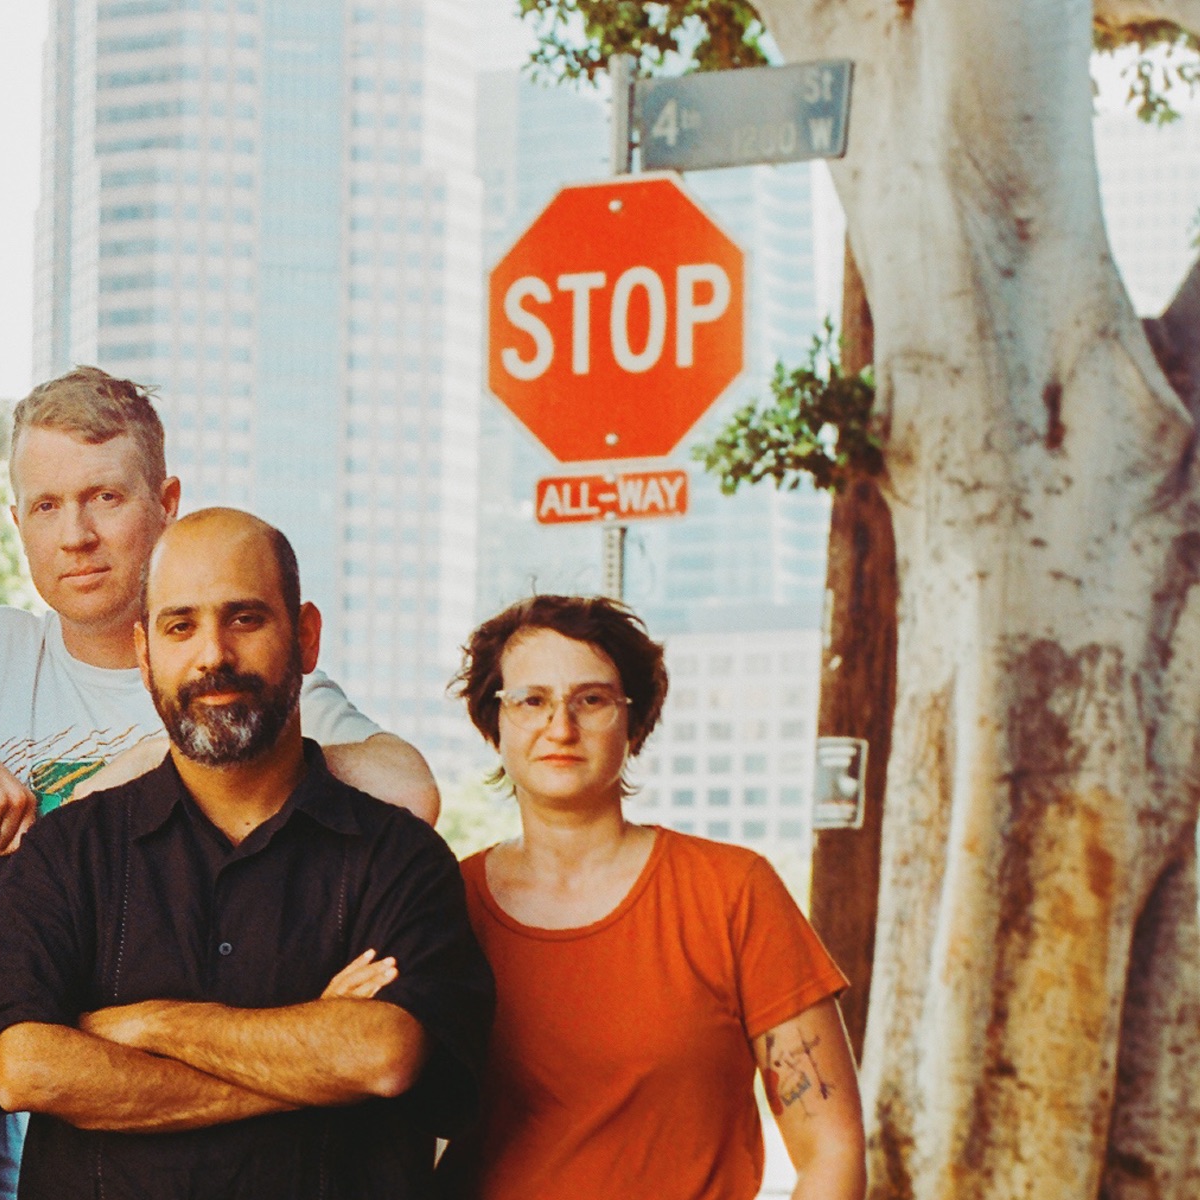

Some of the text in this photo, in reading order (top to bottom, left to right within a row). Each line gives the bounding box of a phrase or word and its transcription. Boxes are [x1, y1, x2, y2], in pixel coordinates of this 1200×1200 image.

[808, 116, 835, 151] W
[501, 263, 732, 381] STOP
[538, 475, 686, 517] ALL-WAY
